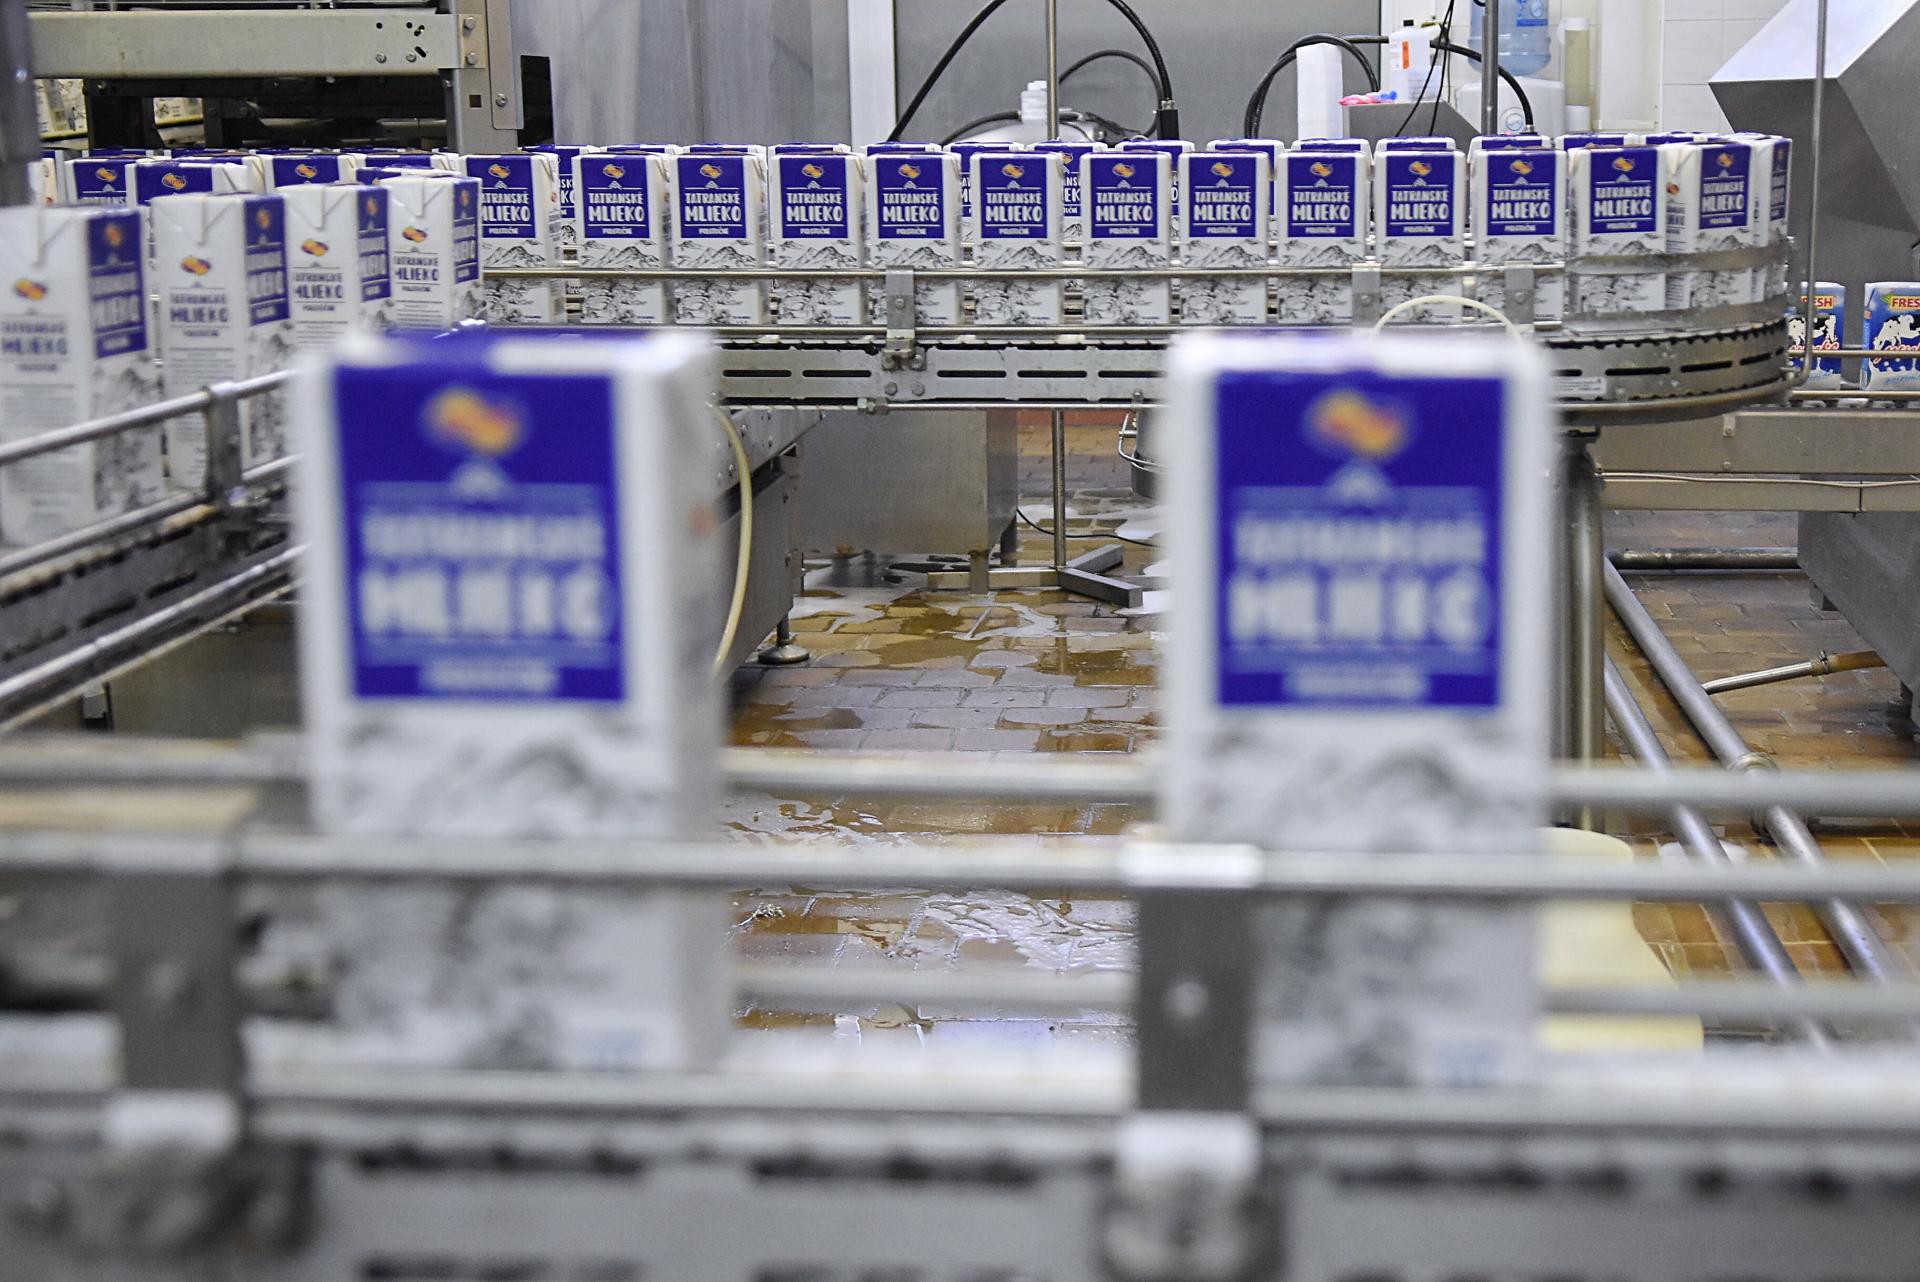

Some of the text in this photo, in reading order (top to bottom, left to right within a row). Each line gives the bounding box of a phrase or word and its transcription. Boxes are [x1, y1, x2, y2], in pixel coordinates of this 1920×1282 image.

[480, 191, 529, 204] ATRANSKÉ
[1701, 194, 1744, 212] MLIEKO
[588, 205, 645, 222] MLIEKO
[685, 205, 742, 222] MLIEKO
[786, 205, 843, 222] MLIEKO
[882, 205, 939, 222] MLIEKO
[985, 205, 1043, 222] MLIEKO
[1095, 205, 1153, 222] MLIEKO
[1193, 204, 1252, 221] MLIEKO
[1292, 203, 1351, 221] MLIEKO
[1391, 203, 1449, 220] MLIEKO
[1491, 201, 1551, 219] MLIEKO
[1593, 199, 1653, 217] MLIEKO
[1892, 298, 1920, 308] FRES
